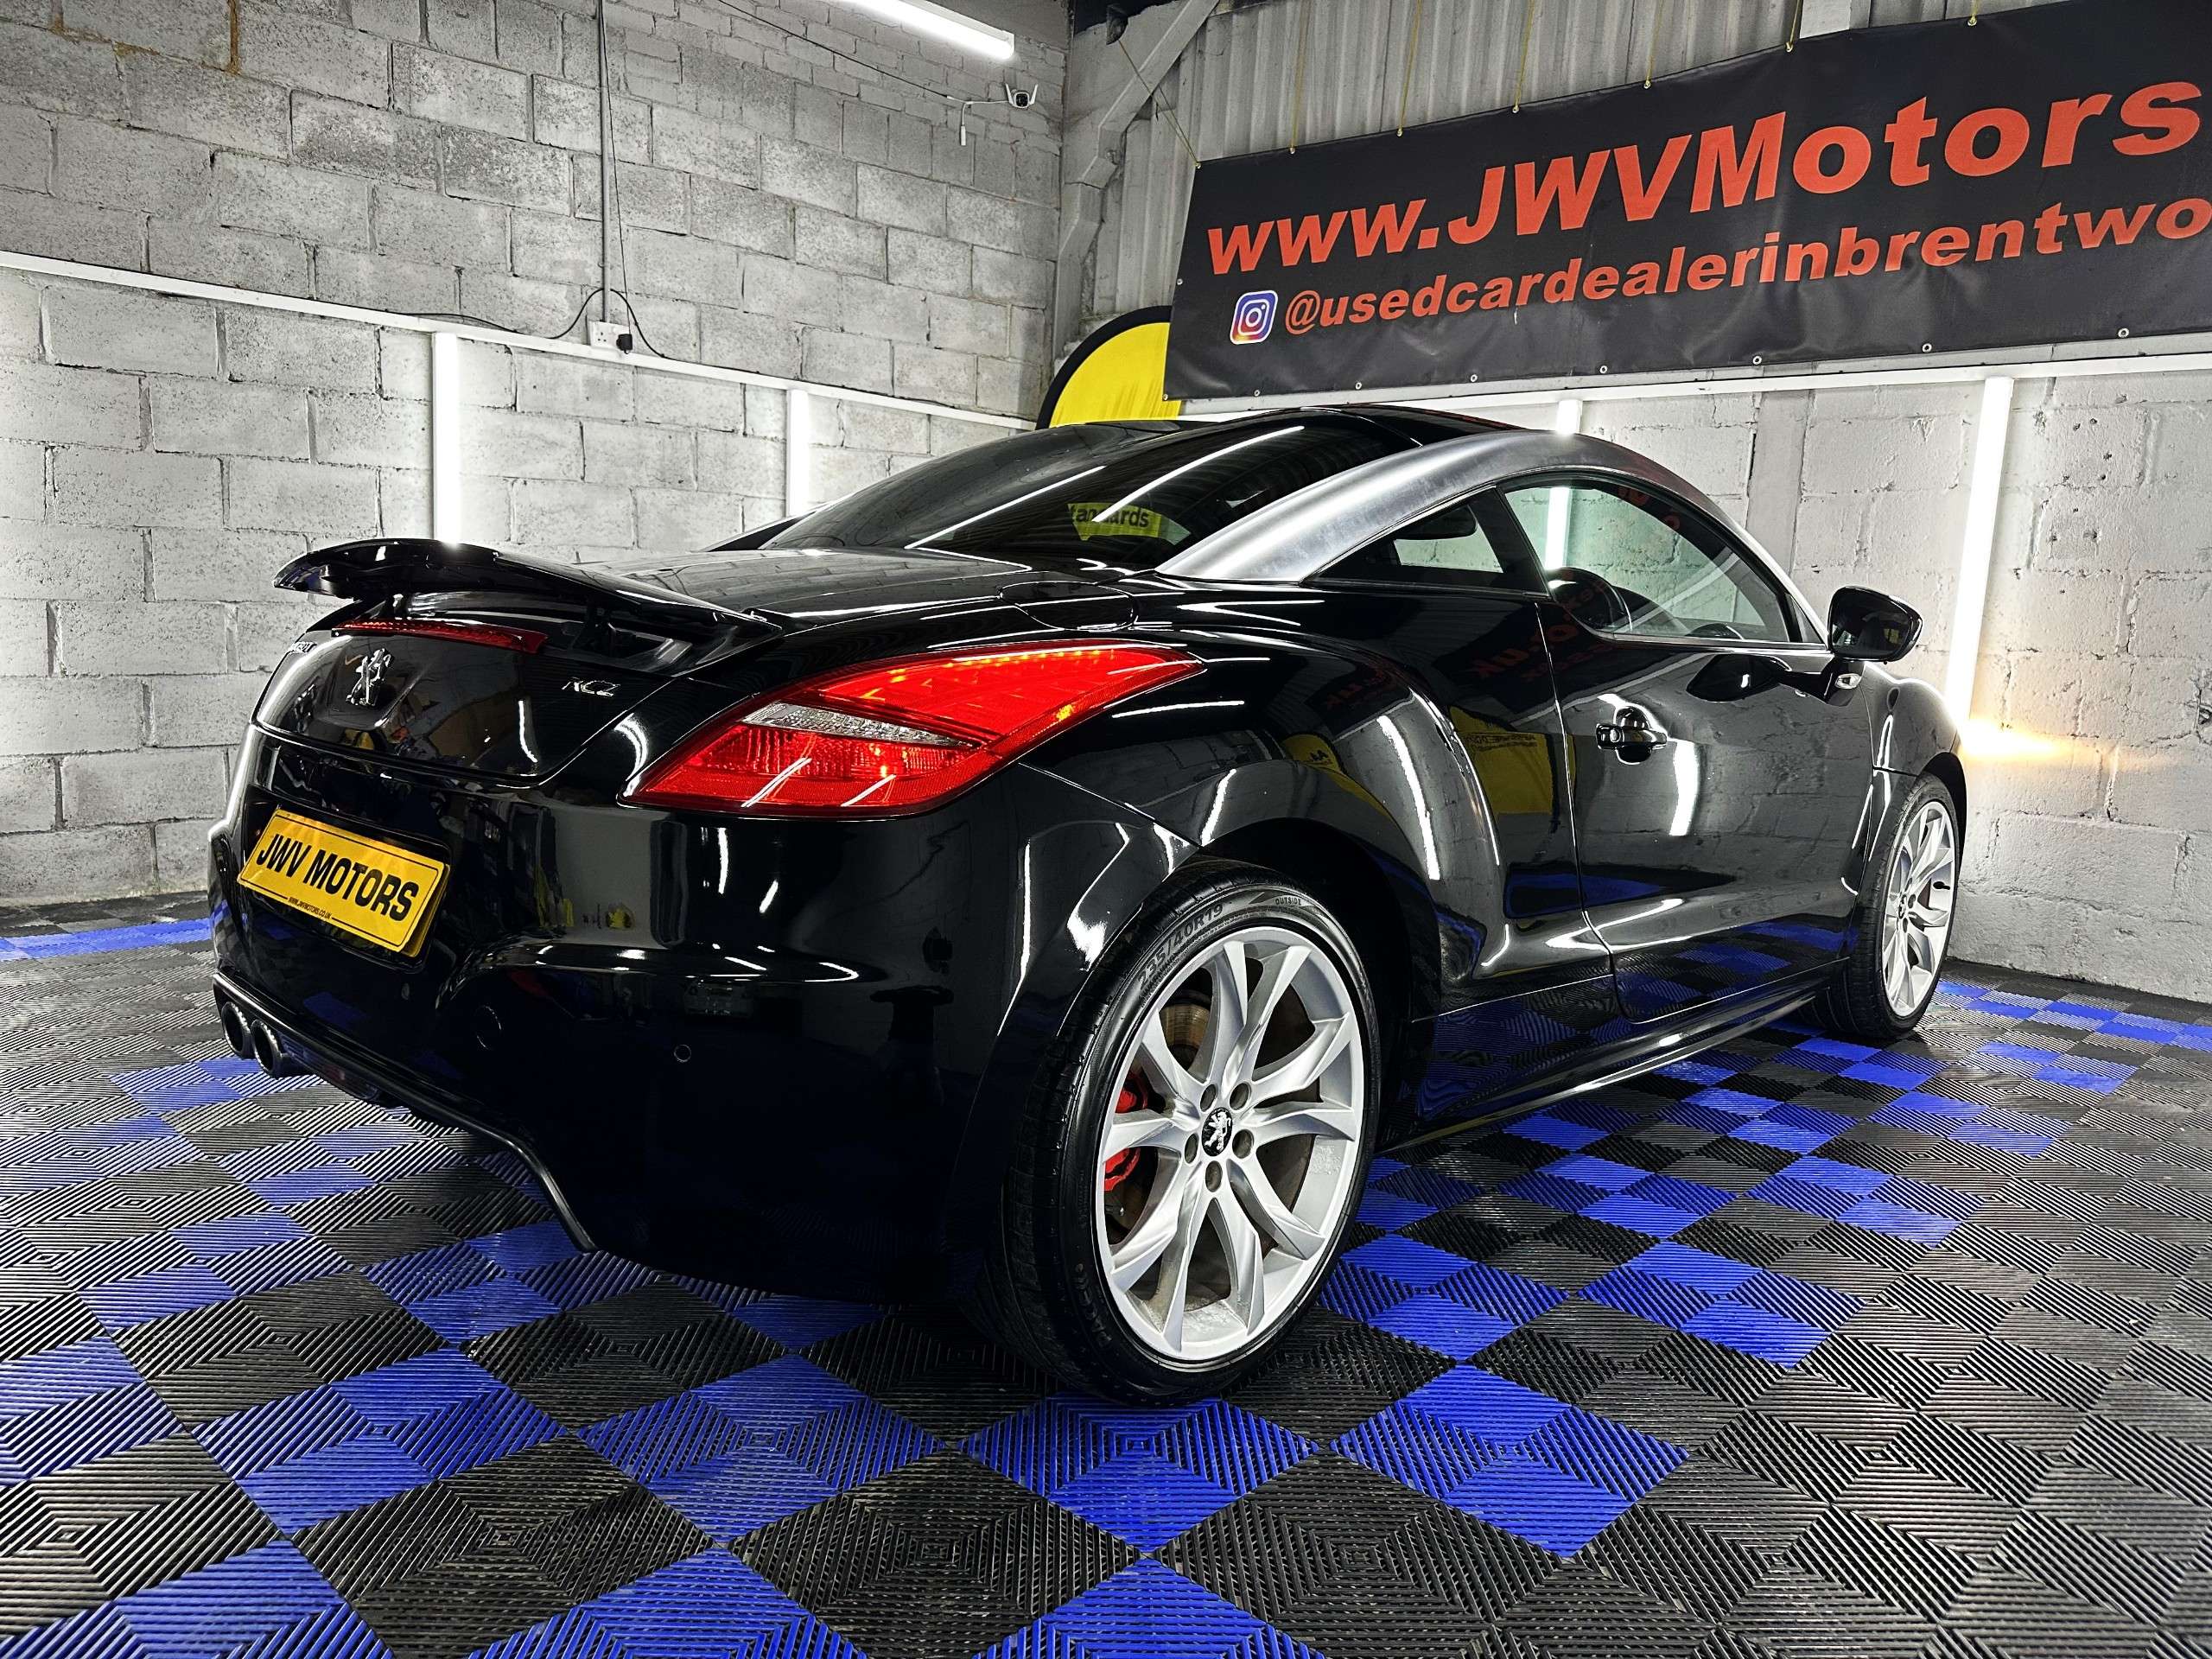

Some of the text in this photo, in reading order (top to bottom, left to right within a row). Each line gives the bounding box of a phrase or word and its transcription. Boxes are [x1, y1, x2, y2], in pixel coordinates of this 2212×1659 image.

[1284, 198, 2212, 335] @usedcardealerinbrentwo
[257, 833, 419, 921] JWV MOTORS
[1274, 896, 1302, 906] OUTSIDE
